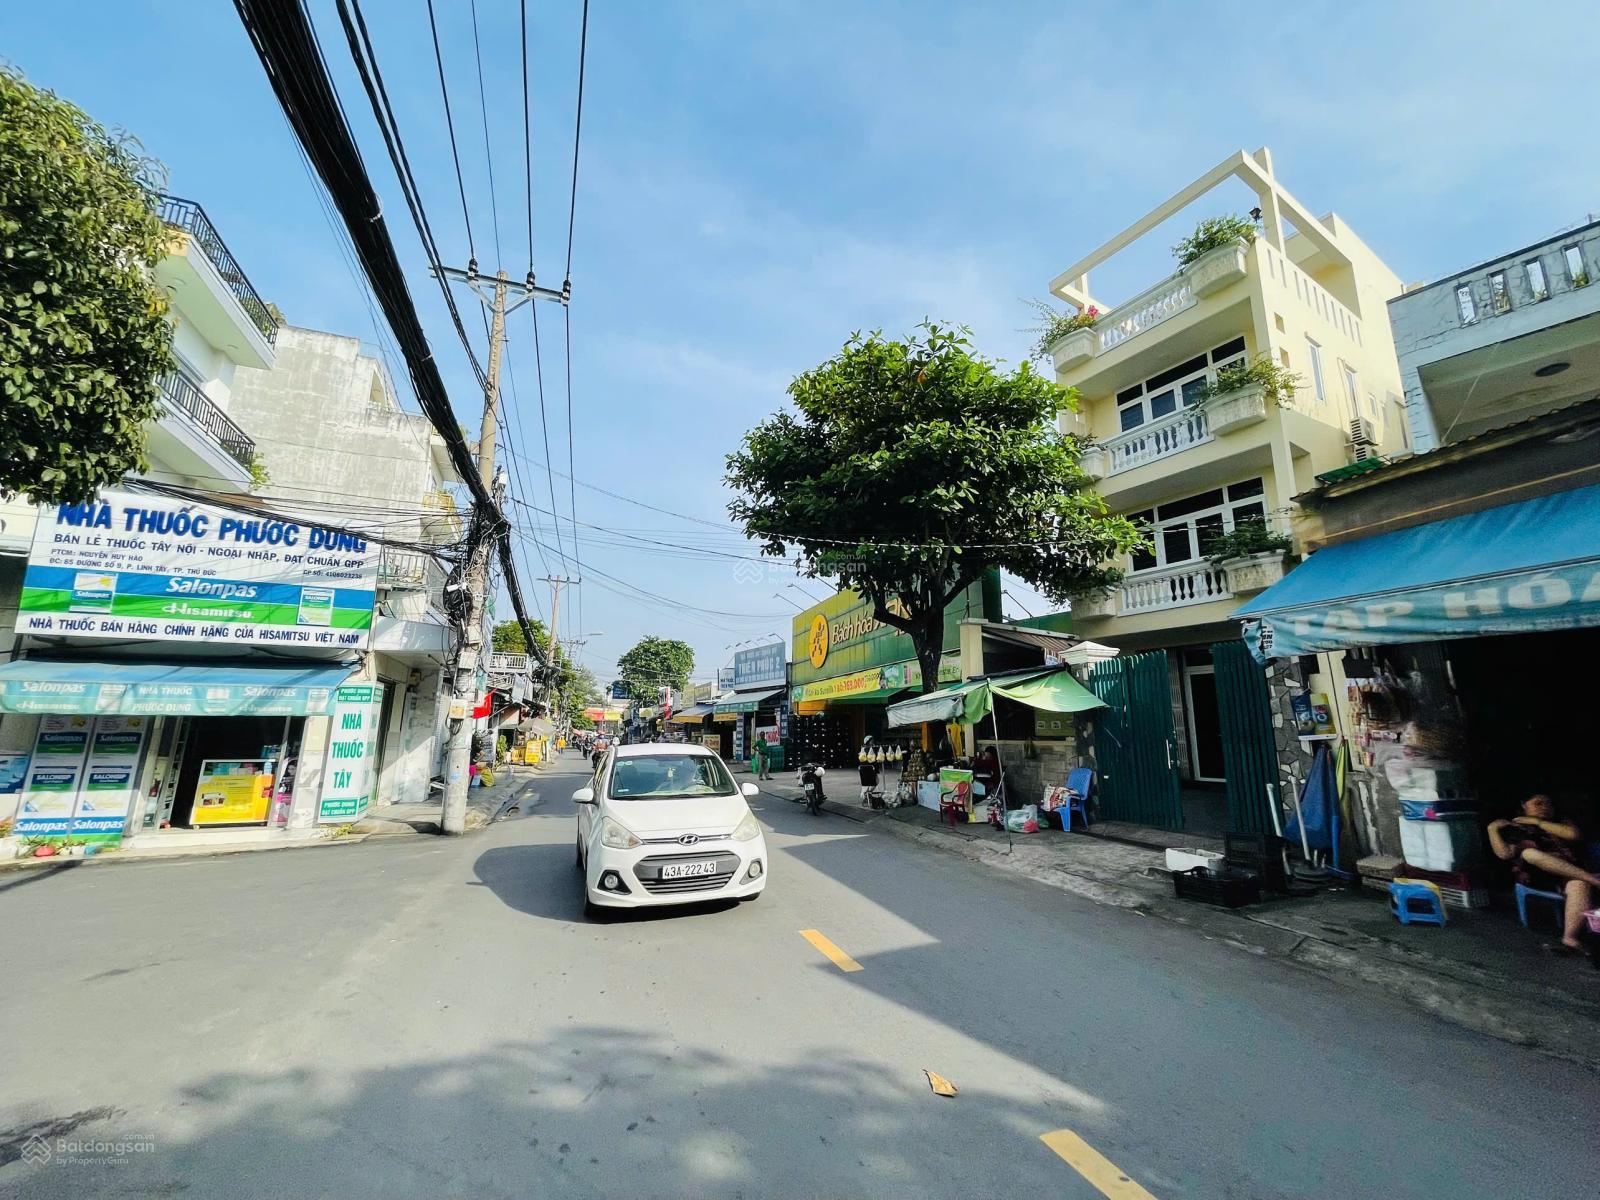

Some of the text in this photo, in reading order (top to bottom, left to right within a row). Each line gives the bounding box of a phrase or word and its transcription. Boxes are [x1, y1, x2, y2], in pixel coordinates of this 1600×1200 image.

[123, 504, 209, 538] THUỐC
[54, 533, 80, 544] BÁN
[86, 533, 101, 546] LẺ
[107, 536, 146, 550] THUỐC
[151, 541, 172, 552] TÂY
[177, 544, 196, 556] NỘI
[208, 546, 242, 558] NGOẠI
[284, 555, 304, 565] ĐẠT
[307, 554, 340, 567] CHUẨN
[344, 559, 364, 569] GPP
[165, 576, 257, 599] Salonpas
[161, 602, 253, 619] Hisamitsu
[29, 616, 52, 629] NHÀ
[59, 616, 96, 631] THUỐC
[101, 620, 123, 633] BÁN
[128, 622, 158, 634] HÀNG
[164, 623, 196, 636] CHÍNH
[234, 626, 254, 639] CỦA
[259, 629, 310, 642] HISAMITSU
[315, 632, 335, 644] VIỆT
[339, 634, 360, 644] NAM
[832, 616, 854, 645] Bách
[855, 610, 873, 637] hóa
[21, 681, 86, 695] Salonpas
[242, 686, 297, 697] Salonpas
[341, 709, 362, 730] NHÀ
[332, 737, 364, 758] THUỐC
[333, 768, 352, 788] TÂY
[14, 821, 68, 832] Salonpas
[71, 820, 124, 831] Salonpas
